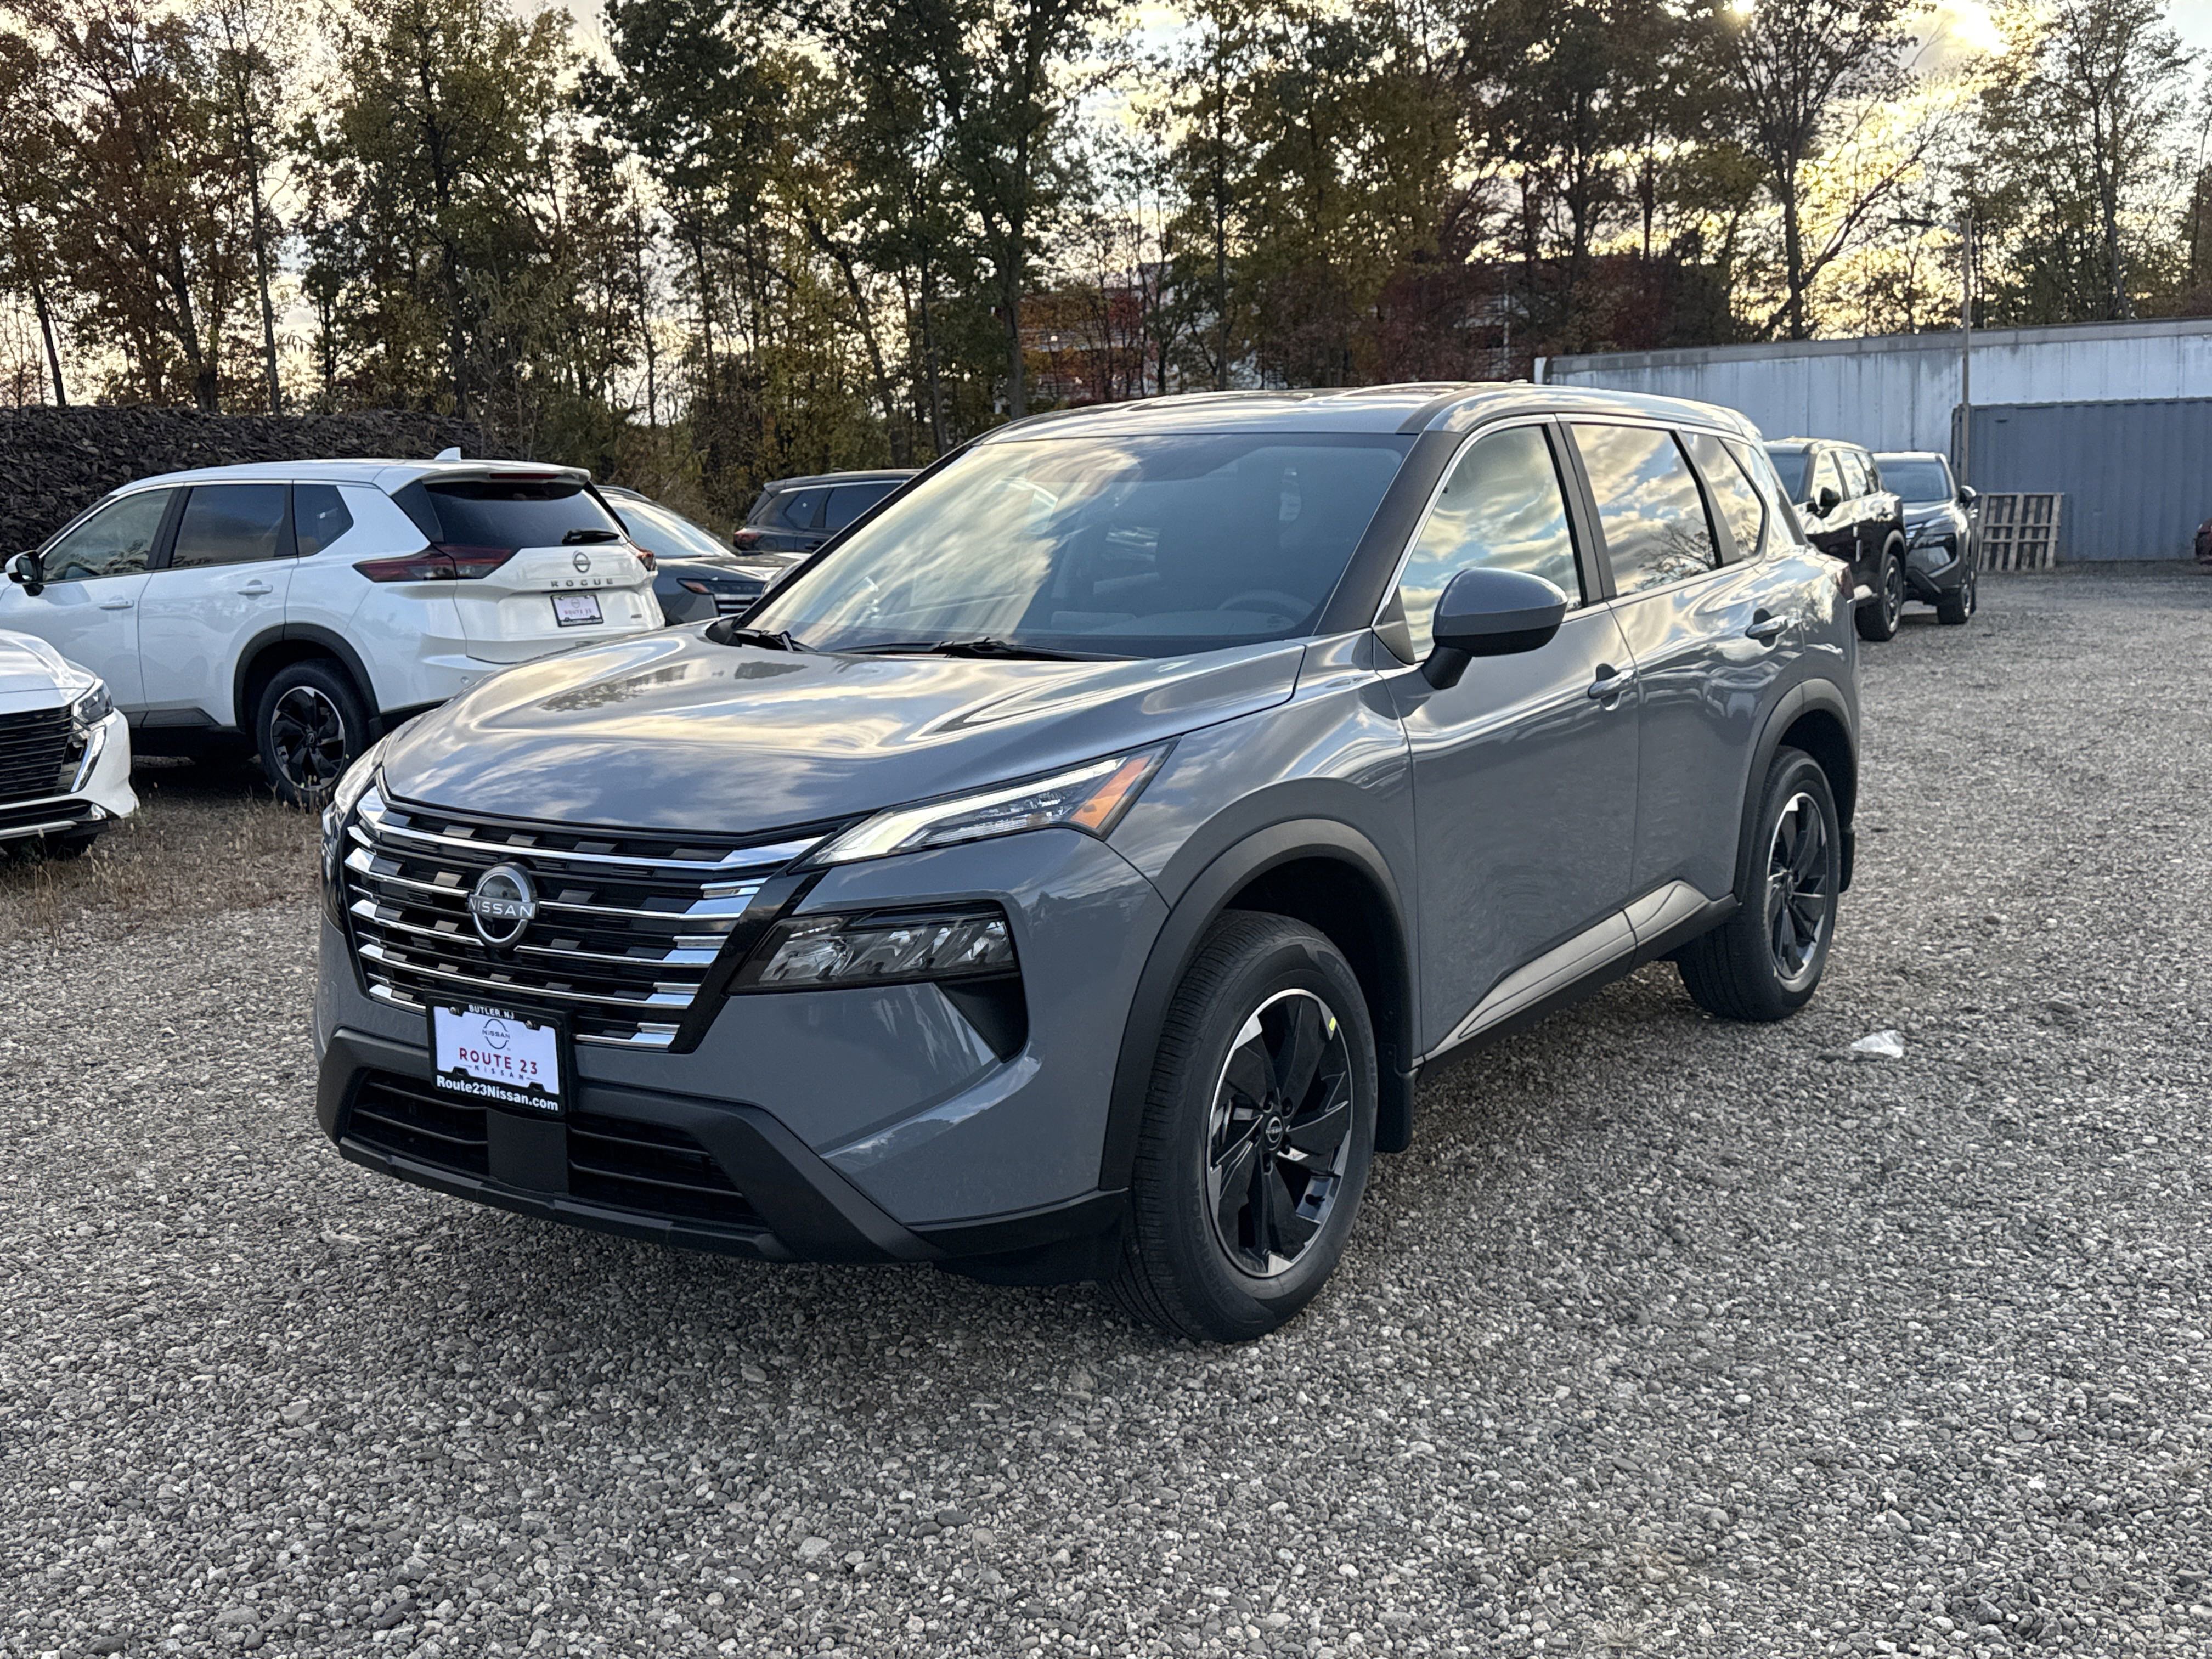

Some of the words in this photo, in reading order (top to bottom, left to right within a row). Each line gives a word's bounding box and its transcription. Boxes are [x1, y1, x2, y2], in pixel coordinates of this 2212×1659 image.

[551, 578, 613, 587] ROGUE
[469, 898, 533, 917] NISSAN
[504, 1011, 515, 1020] NJ
[482, 1029, 510, 1039] NISSAN
[459, 1048, 512, 1070] ROUTE
[520, 1060, 538, 1075] 23
[475, 1065, 524, 1080] NISSAN
[437, 1075, 558, 1111] Route23Nissan.com
